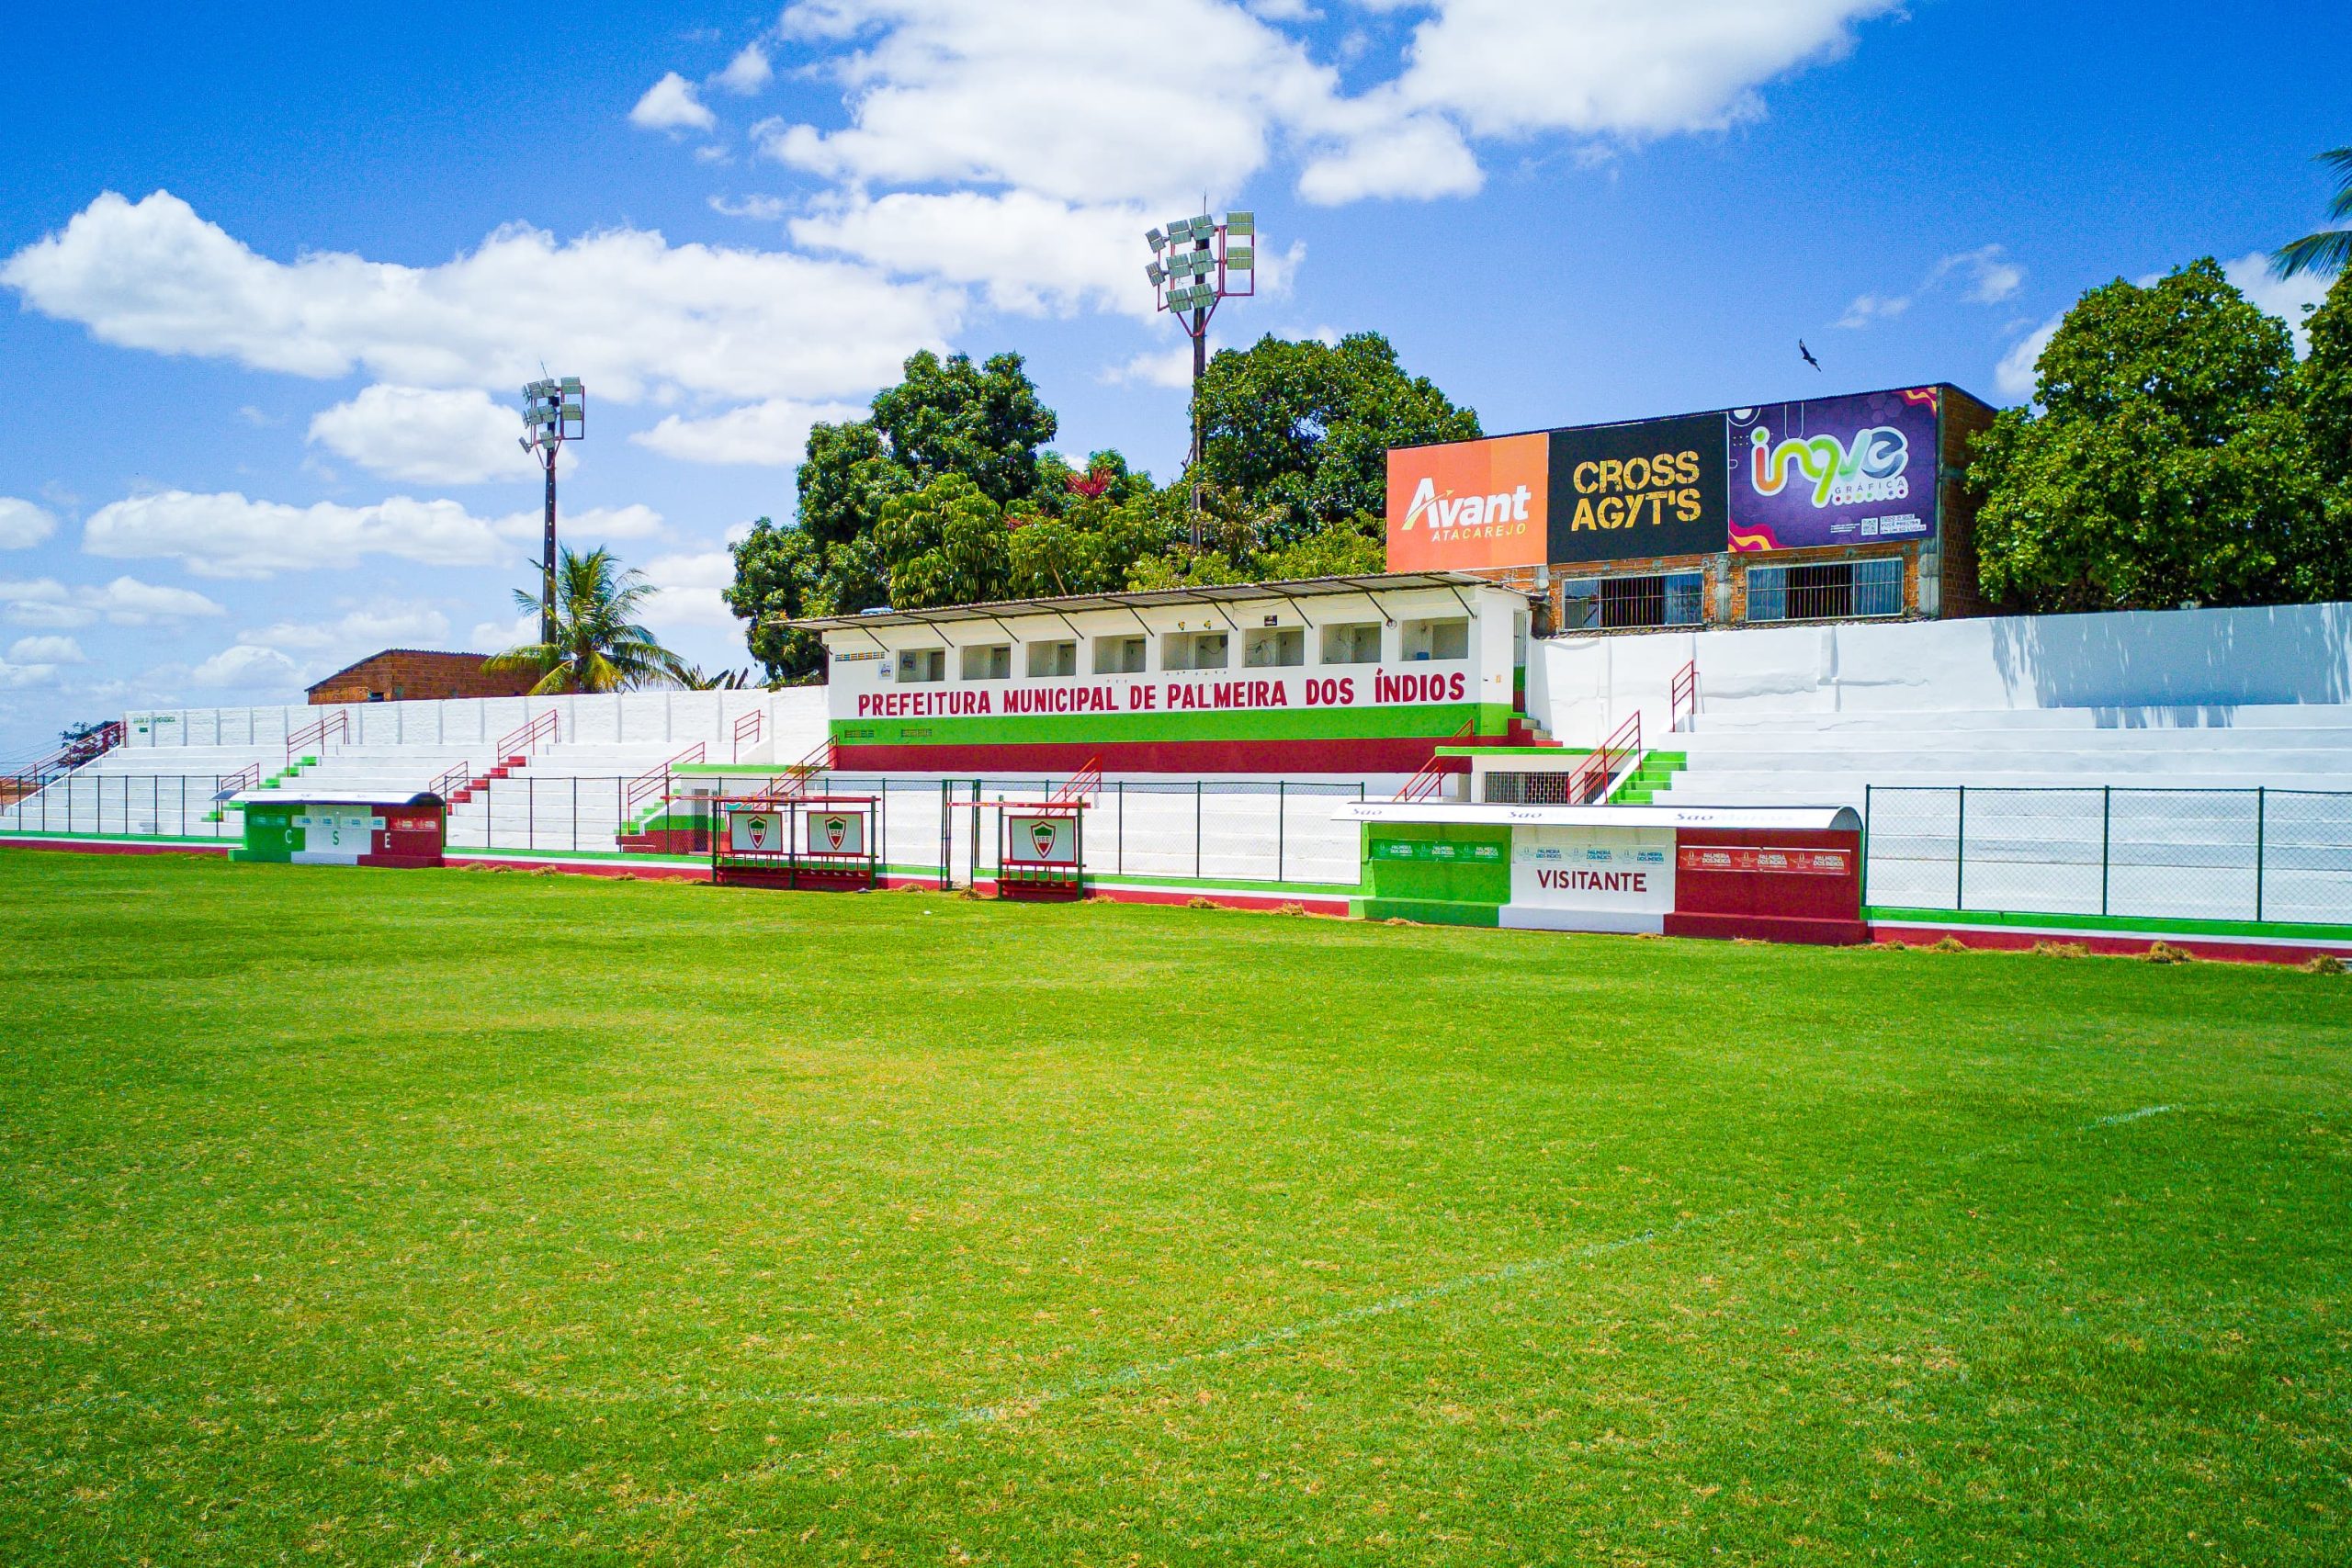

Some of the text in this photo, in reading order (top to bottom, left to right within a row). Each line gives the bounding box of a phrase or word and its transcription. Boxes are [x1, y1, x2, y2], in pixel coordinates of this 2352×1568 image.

[1573, 450, 1700, 494] CROSS
[1834, 479, 1905, 494] GRÁFICA
[1401, 477, 1532, 530] Avant
[1571, 488, 1702, 532] AGYT'S
[1431, 523, 1527, 542] ATACAREJO
[858, 668, 1465, 716] PREFEITURA MUNICIPAL DE PALMEIRA DOS ÍNDIOS
[285, 829, 391, 849] C S E
[1537, 869, 1647, 893] VISITANTE
